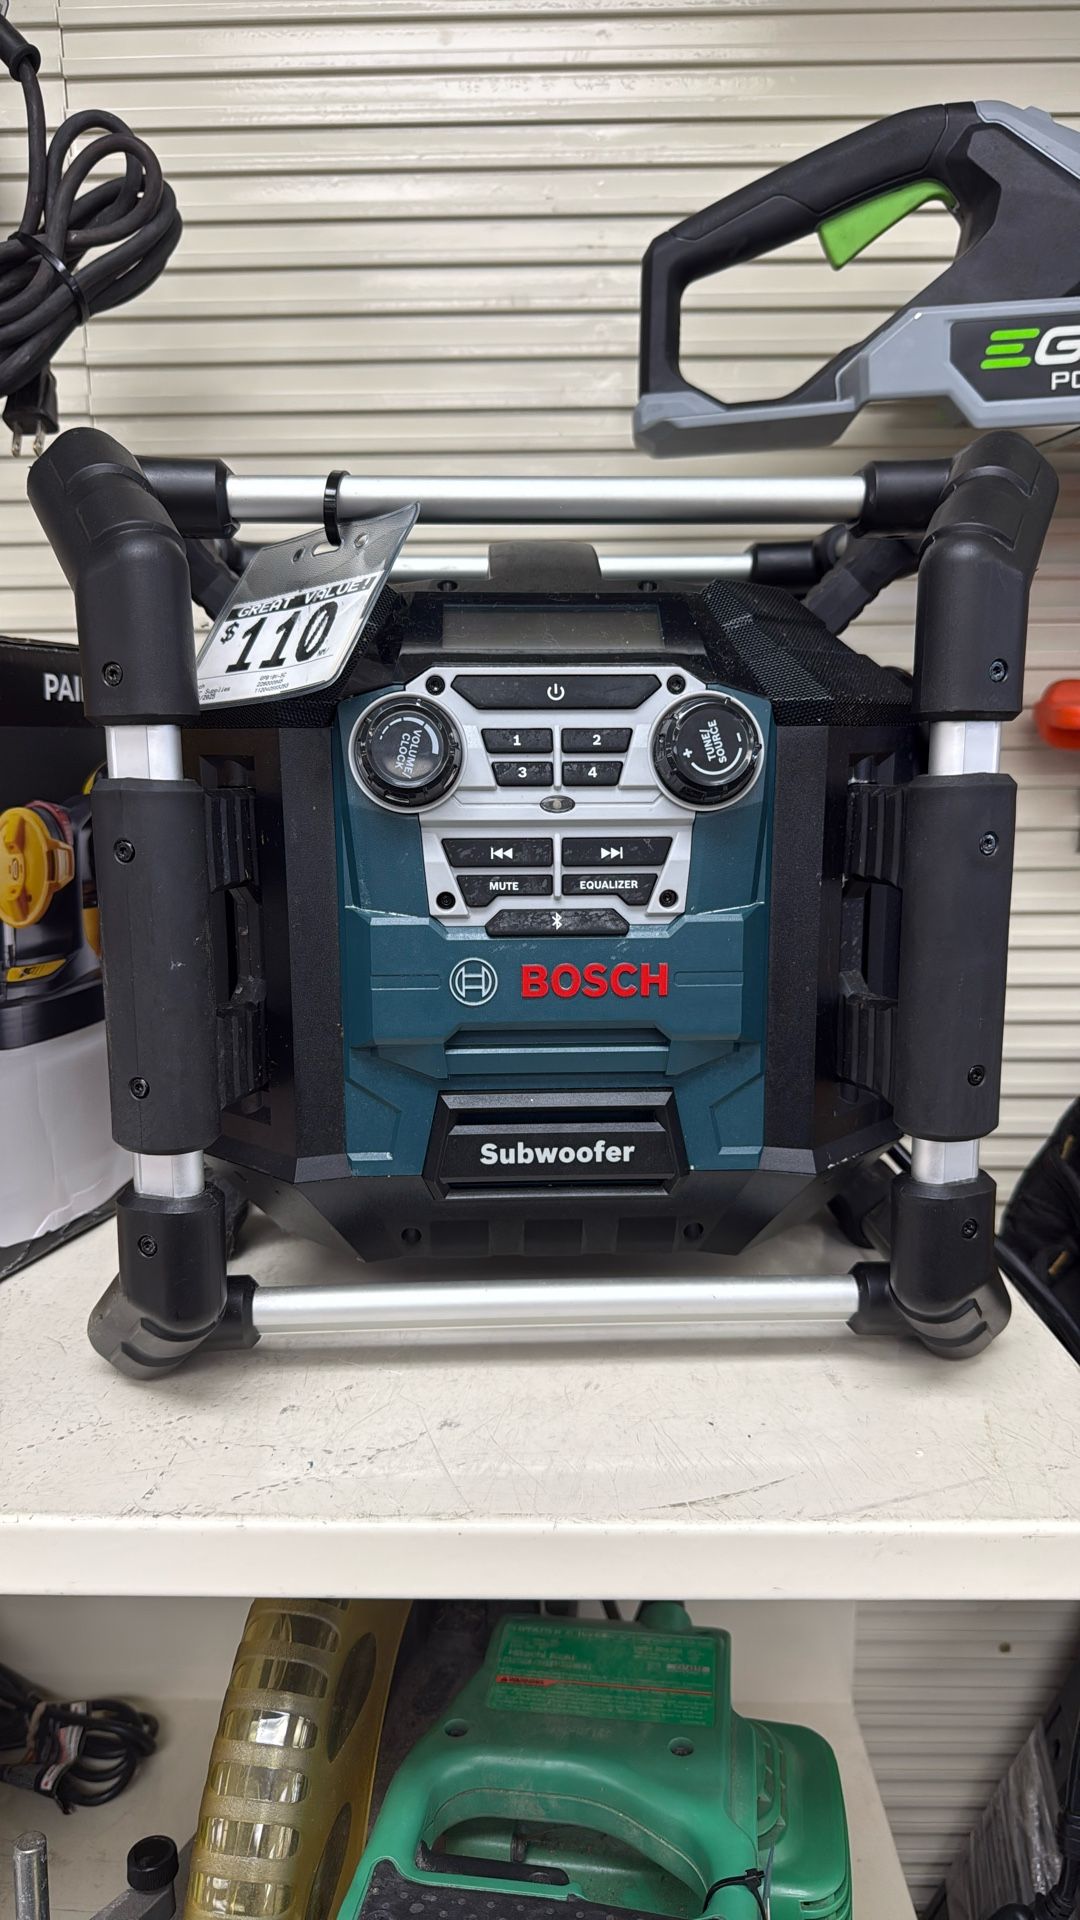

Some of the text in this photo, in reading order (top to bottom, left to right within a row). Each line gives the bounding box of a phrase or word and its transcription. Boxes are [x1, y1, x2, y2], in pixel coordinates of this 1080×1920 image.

[237, 577, 373, 617] GREAT VALUE!
[44, 673, 85, 702] PAI
[394, 733, 411, 770] CLOCK
[513, 734, 522, 746] 1
[592, 734, 602, 746] 2
[699, 729, 716, 762] TUNE/
[708, 719, 727, 764] SOURCE
[402, 729, 423, 779] VOLUME/
[518, 767, 527, 778] 3
[587, 766, 598, 778] 4
[489, 881, 519, 891] MUTE
[579, 880, 639, 890] EQUALIZER
[521, 962, 669, 998] BOSCH
[480, 1140, 635, 1165] Subwoofer
